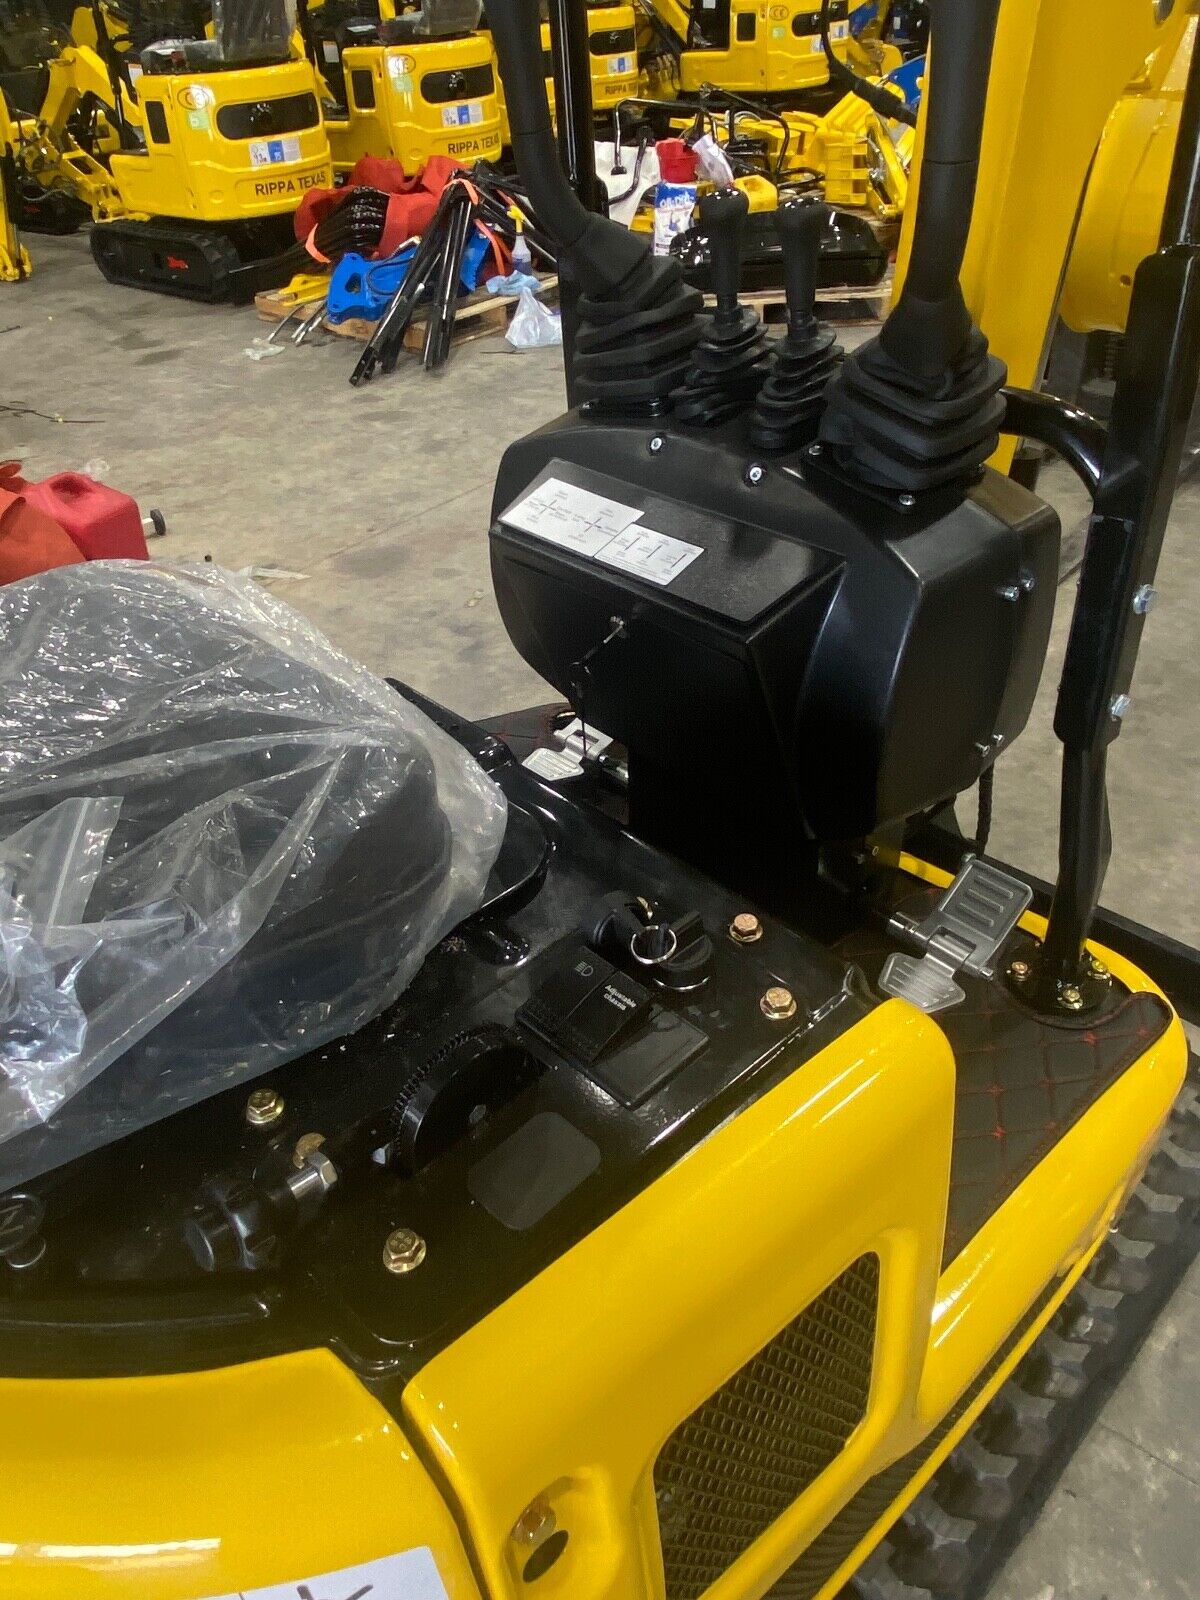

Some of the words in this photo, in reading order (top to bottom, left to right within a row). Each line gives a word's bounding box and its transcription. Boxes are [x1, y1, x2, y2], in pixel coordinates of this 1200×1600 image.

[447, 141, 480, 155] RIPPA
[254, 180, 296, 196] RIPPA
[297, 171, 327, 190] TEXAS
[605, 985, 636, 1008] Adjustable
